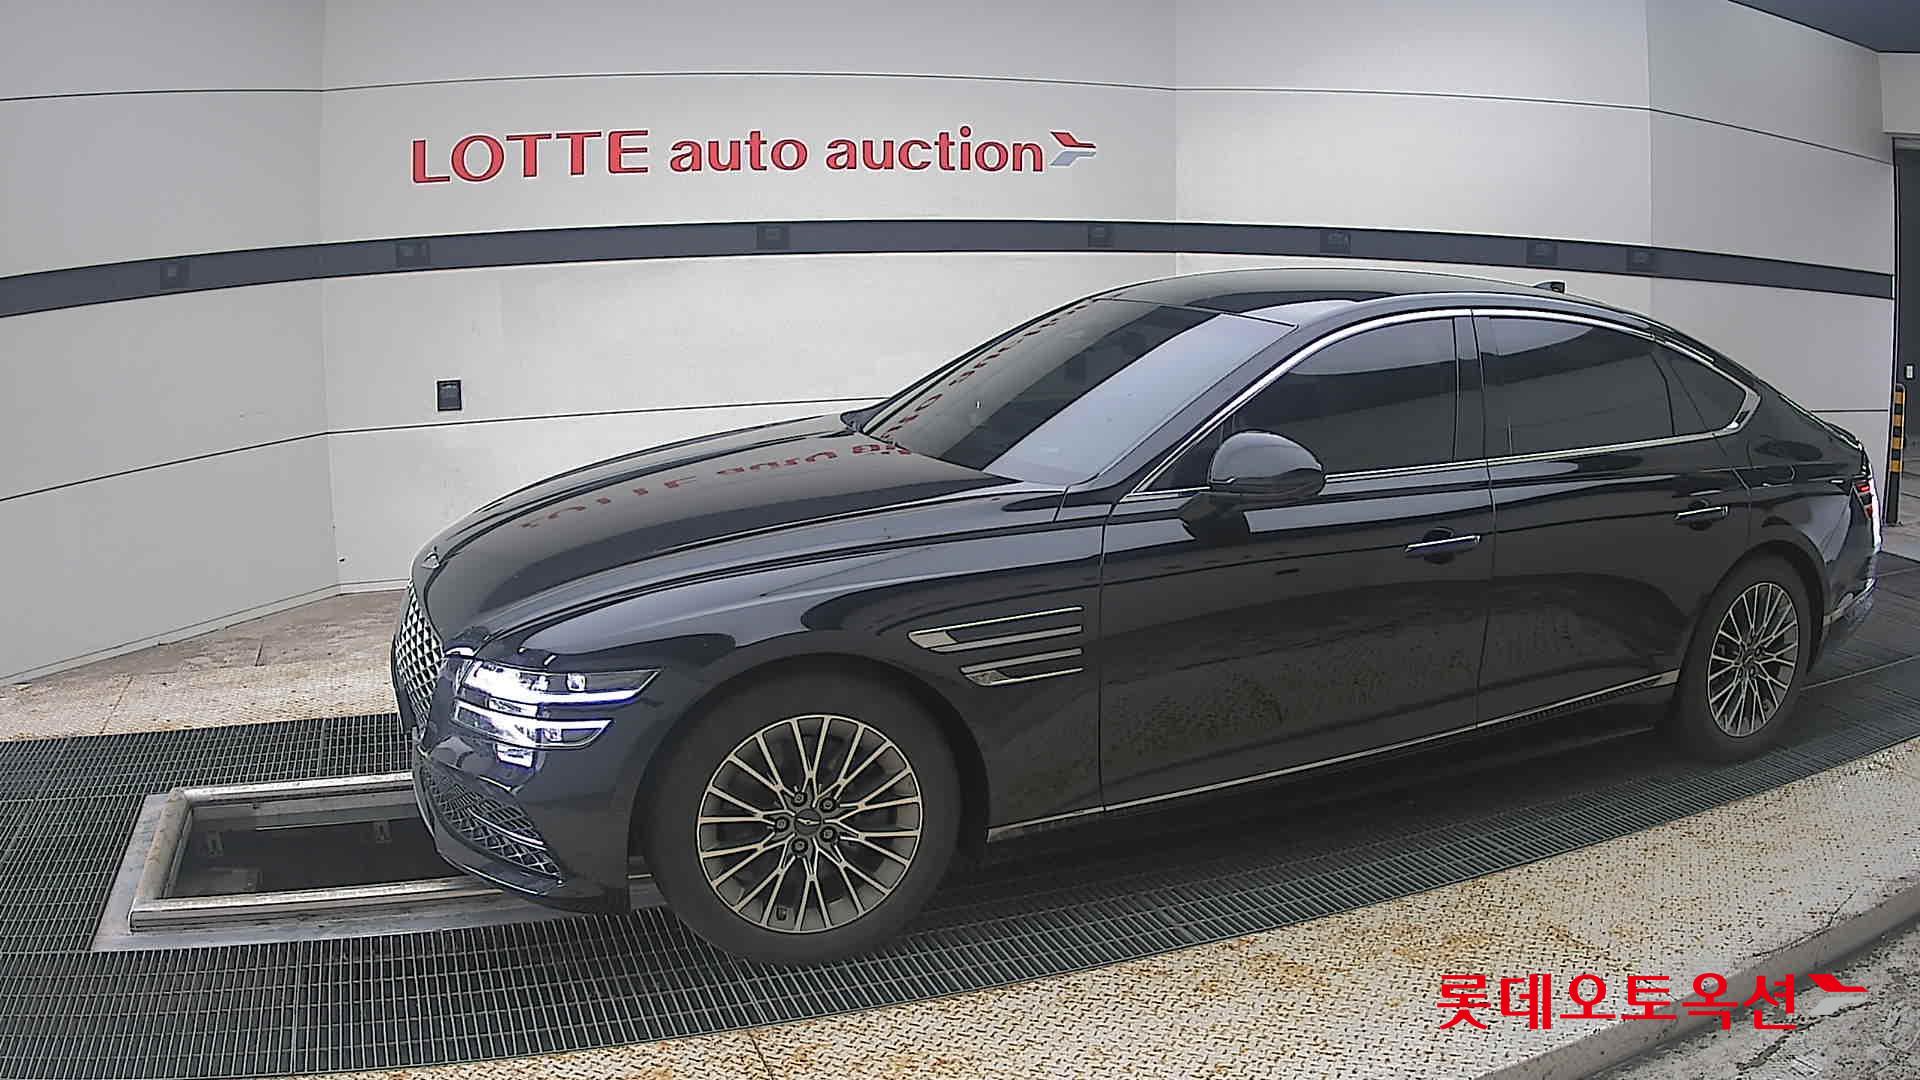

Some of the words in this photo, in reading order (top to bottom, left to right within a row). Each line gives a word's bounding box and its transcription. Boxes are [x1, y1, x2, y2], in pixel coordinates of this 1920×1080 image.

[412, 130, 649, 184] LOTTE
[669, 130, 809, 172] auto
[825, 126, 1044, 172] auction
